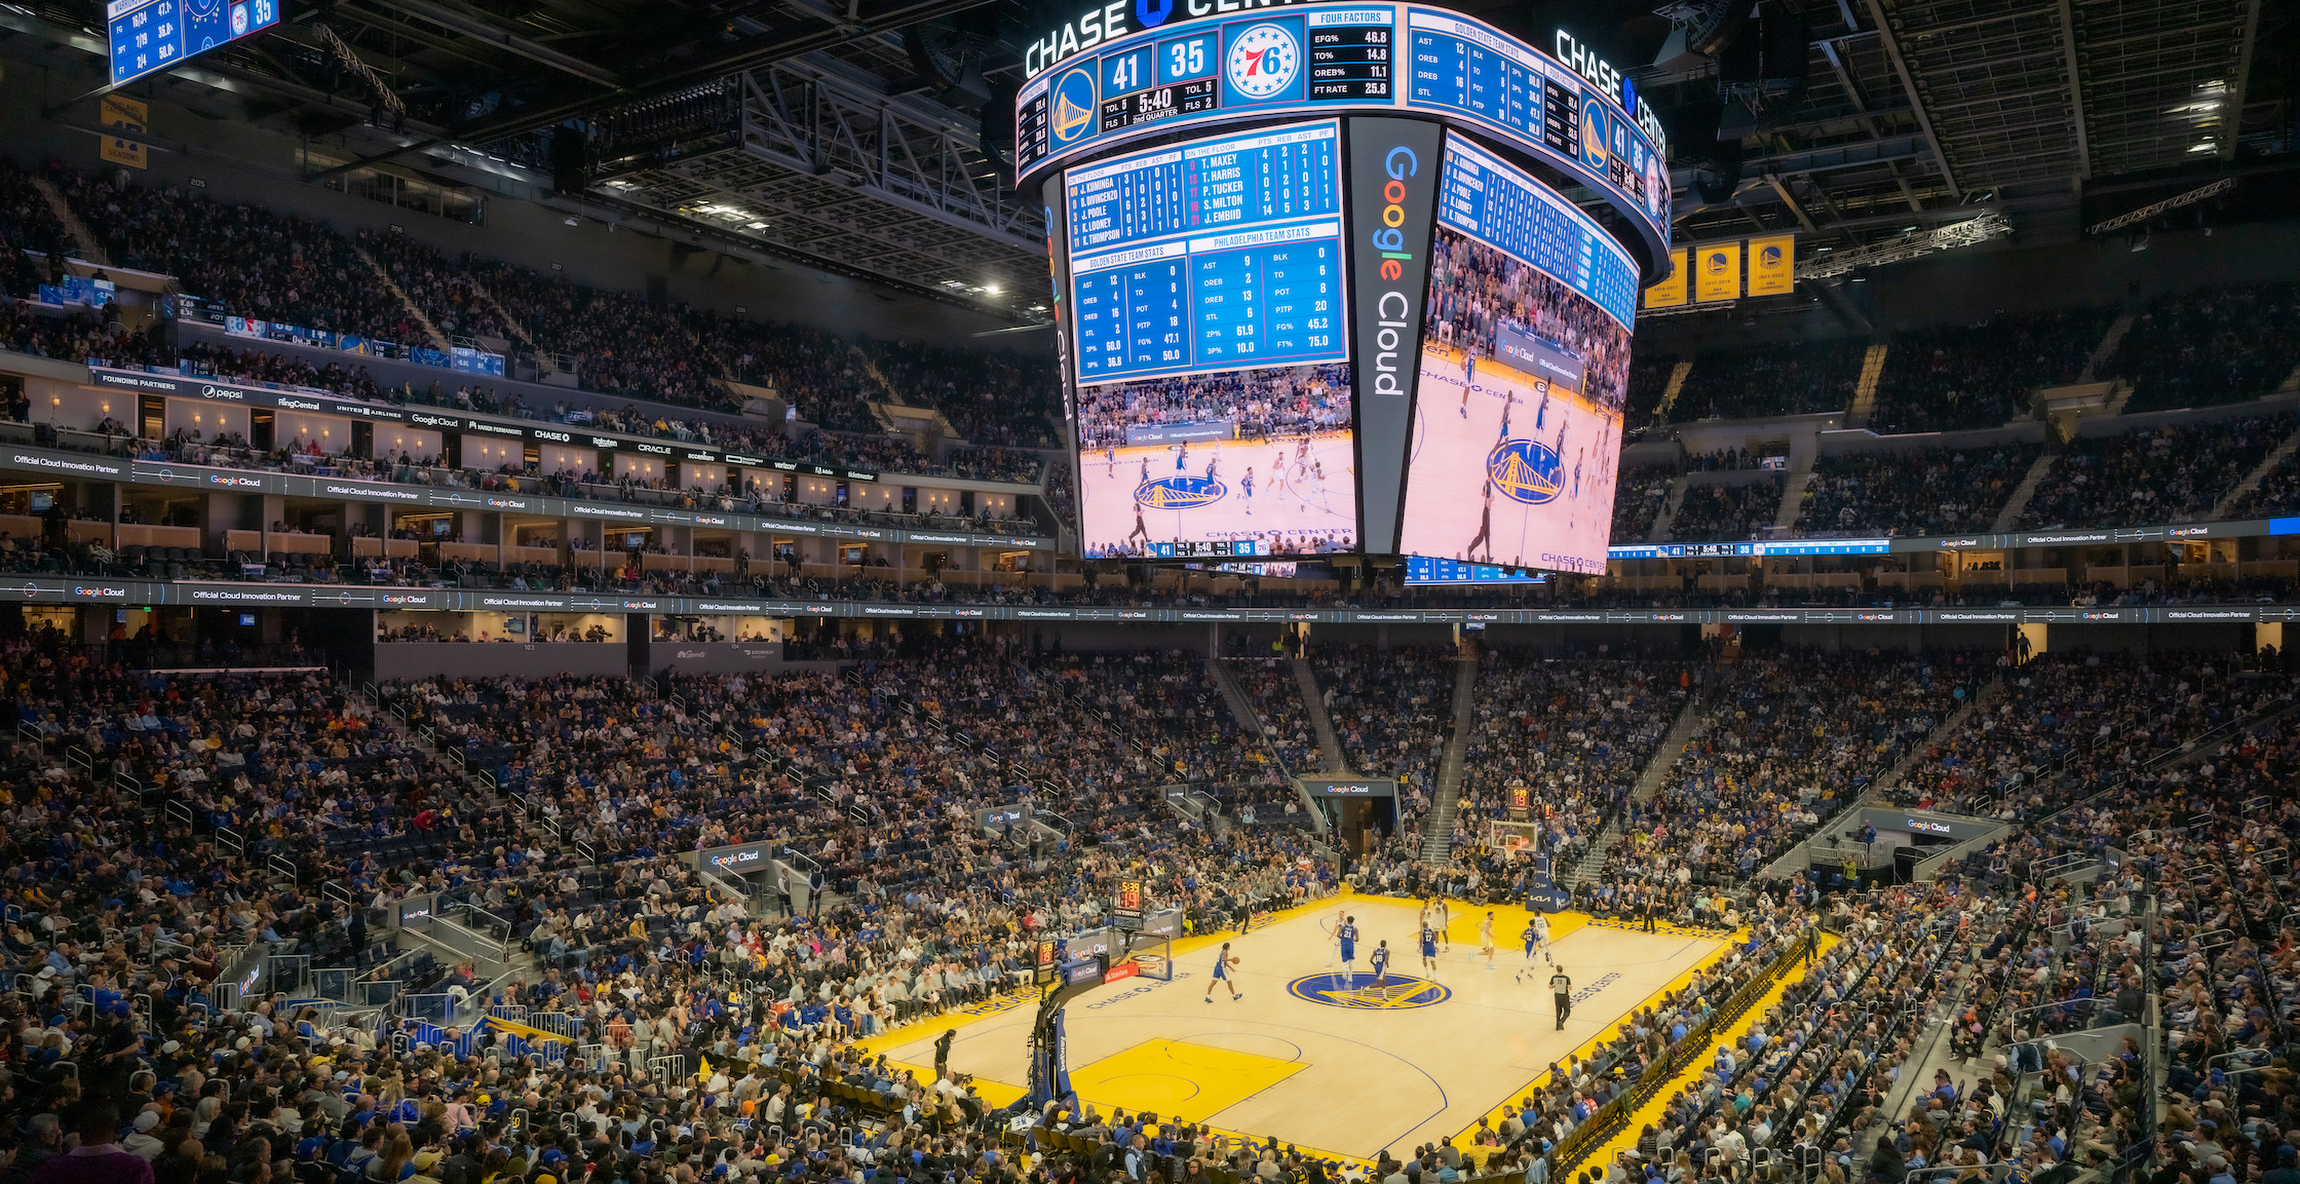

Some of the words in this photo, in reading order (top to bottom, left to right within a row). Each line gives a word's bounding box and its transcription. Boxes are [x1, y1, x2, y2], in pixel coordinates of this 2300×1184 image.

[1321, 14, 1343, 23] FOUR
[1344, 13, 1381, 23] FACTORS
[1025, 0, 1128, 79] CHASE
[1315, 35, 1339, 43] EFG%
[1365, 32, 1386, 43] 46.8
[1171, 40, 1204, 77] 35
[1367, 49, 1386, 60] 14.8
[1246, 47, 1281, 77] 76
[1556, 29, 1621, 105] CHASE
[1113, 54, 1138, 90] 41
[1315, 68, 1345, 77] OREB%
[1371, 66, 1386, 77] 11.1
[1184, 85, 1201, 94] TOL
[1206, 81, 1212, 92] 5
[1315, 86, 1325, 94] FT
[1327, 85, 1347, 93] RATE
[1365, 83, 1386, 94] 25.8
[1106, 105, 1119, 113] TOL
[1122, 100, 1127, 110] 5
[1139, 89, 1172, 113] 5:40
[1185, 100, 1200, 110] FLS
[1205, 98, 1212, 108] 2
[1106, 119, 1118, 129] FLS
[1123, 115, 1127, 125] 1
[1133, 115, 1145, 124] 2nd
[1146, 109, 1178, 121] QUARTER
[1638, 96, 1667, 162] CENTER
[1277, 135, 1292, 143] REB
[1615, 124, 1625, 157] 41
[1212, 144, 1235, 153] FLOOR
[1190, 160, 1195, 171] 0
[1202, 158, 1209, 169] T.
[1211, 154, 1237, 167] MAXEY
[1633, 140, 1643, 173] 35
[1189, 174, 1198, 185] 12
[1202, 172, 1209, 183] T.
[1211, 167, 1240, 181] HARRIS
[1070, 186, 1078, 197] 00
[1080, 184, 1085, 194] J.
[1086, 178, 1114, 192] KUMINGA
[1190, 188, 1198, 198] 17
[1203, 186, 1211, 197] P.
[1212, 181, 1243, 195] TUCKER
[1073, 200, 1077, 210] 0
[1088, 190, 1118, 206] DIVINCENZO
[1190, 202, 1199, 212] 18
[1204, 200, 1211, 210] S.
[1213, 194, 1243, 208] MILTON
[1074, 212, 1077, 222] 3
[1082, 210, 1087, 220] J.
[1088, 206, 1106, 219] POOLE
[1191, 215, 1199, 226] 21
[1204, 213, 1212, 224] J.
[1214, 209, 1241, 222] EMBIID
[1372, 146, 1418, 281] Google
[1074, 225, 1078, 235] 5
[1082, 223, 1088, 233] K.
[1089, 218, 1111, 231] LOONEY
[1074, 238, 1079, 247] 11
[1083, 236, 1088, 246] K.
[1089, 229, 1120, 244] THOMPSON
[1214, 233, 1263, 247] PHILADELPHIA
[1265, 231, 1285, 240] TEAM
[1287, 228, 1310, 238] STATS
[1319, 248, 1324, 258] 0
[1245, 256, 1250, 266] 9
[1320, 265, 1325, 275] 6
[1246, 273, 1251, 283] 2
[1275, 288, 1290, 296] POT
[1320, 283, 1326, 293] 8
[1205, 296, 1223, 304] DREB
[1243, 290, 1252, 301] 13
[1315, 300, 1327, 311] 20
[1247, 307, 1252, 318] 6
[1308, 318, 1328, 329] 45.2
[1237, 325, 1253, 336] 61.9
[1236, 342, 1254, 353] 10.0
[1308, 335, 1328, 347] 75.0
[1375, 291, 1408, 395] Cloud
[103, 376, 138, 385] FOUNDING
[140, 380, 175, 390] PARTNERS
[216, 389, 242, 399] pepsi
[278, 398, 319, 410] RingCentral
[371, 410, 401, 418] AIRLINES
[412, 414, 437, 426] Google
[438, 418, 458, 427] Cloud
[535, 430, 561, 441] CHASE
[638, 444, 671, 454] ORACLE
[14, 455, 39, 464] Official
[40, 458, 60, 467] Cloud
[62, 461, 94, 471] Innovation
[96, 465, 119, 474] Partner
[210, 475, 238, 486] Google
[239, 478, 260, 486] Cloud
[1161, 545, 1169, 555] 41
[1195, 542, 1211, 552] 5:40
[1239, 543, 1250, 553] 35
[75, 586, 102, 597] Google
[103, 588, 124, 596] Cloud
[193, 591, 218, 599] Official
[220, 591, 240, 599] Cloud
[383, 595, 407, 605] Google
[407, 595, 426, 603] Cloud
[1328, 785, 1350, 794] Google
[1908, 819, 1931, 831] Google
[1931, 823, 1949, 832] Cloud
[711, 854, 737, 865] Google
[738, 851, 758, 861] Cloud
[1122, 882, 1140, 893] 5:39
[1125, 893, 1137, 909] 19
[1086, 988, 1134, 1010] CHASE
